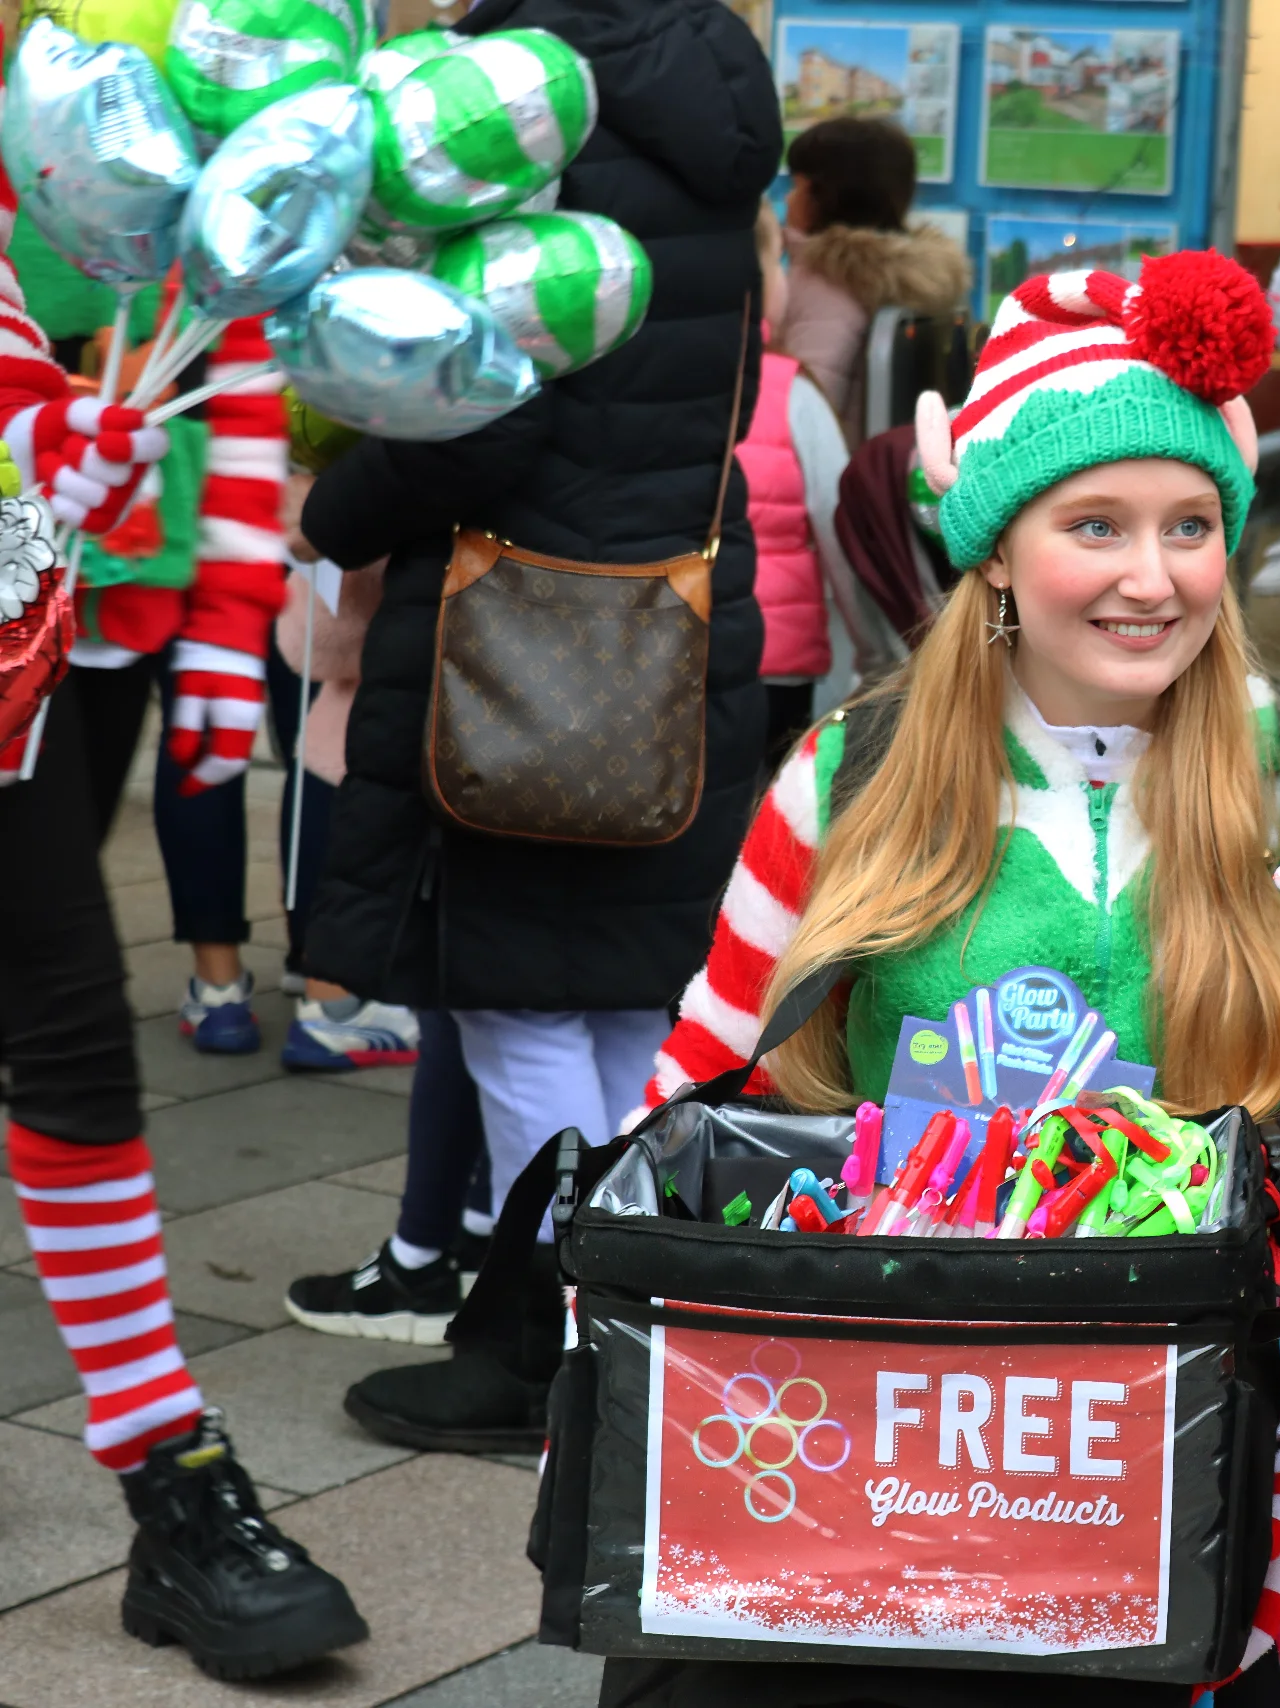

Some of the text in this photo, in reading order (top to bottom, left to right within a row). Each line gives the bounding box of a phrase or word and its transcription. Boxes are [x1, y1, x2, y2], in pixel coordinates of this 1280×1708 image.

[1001, 982, 1058, 1012] Glow
[1010, 1006, 1076, 1036] Party
[874, 1370, 1130, 1481] FREE
[865, 1476, 1124, 1527] Glow Products
